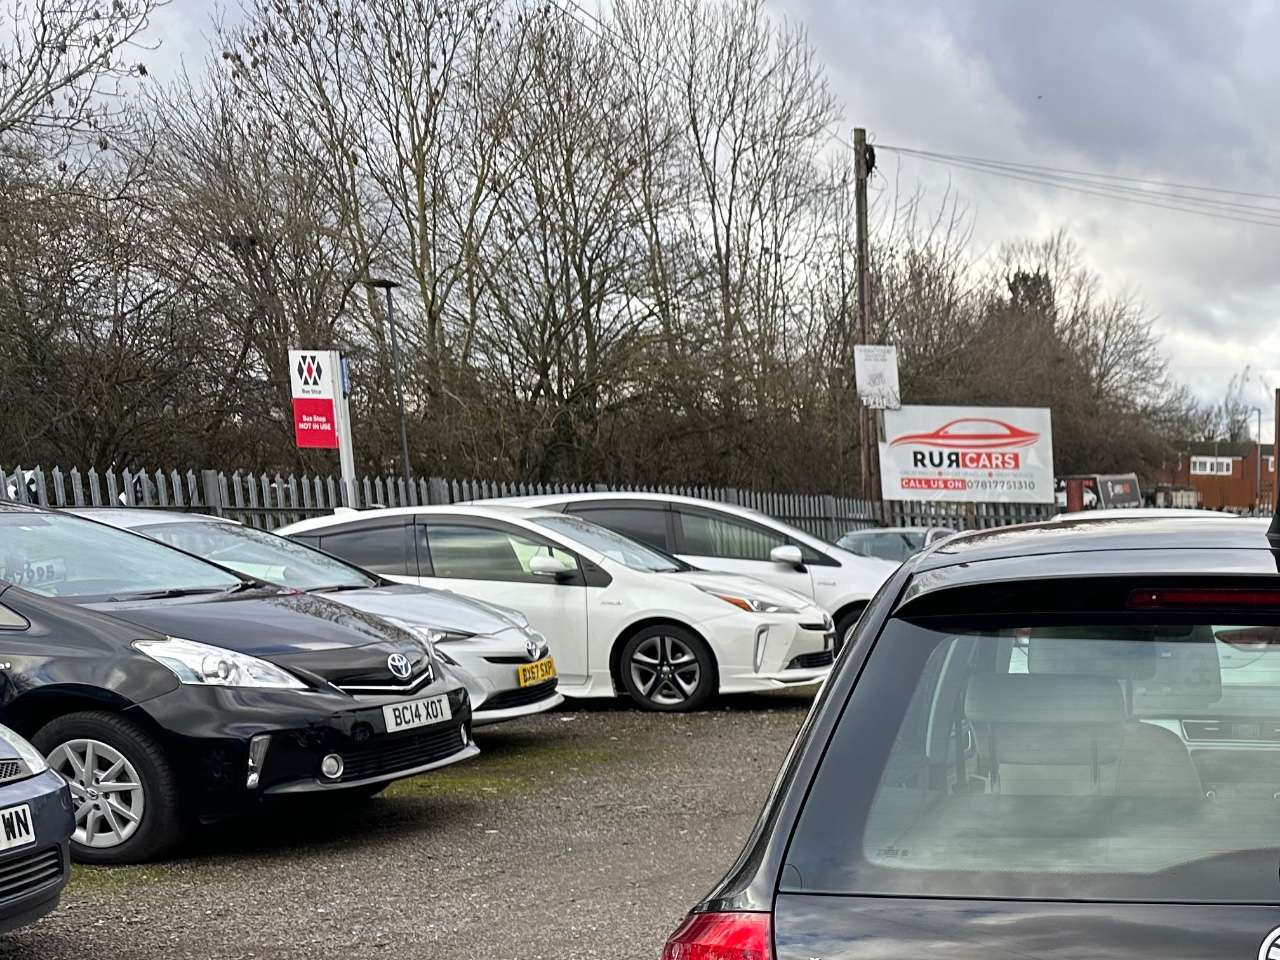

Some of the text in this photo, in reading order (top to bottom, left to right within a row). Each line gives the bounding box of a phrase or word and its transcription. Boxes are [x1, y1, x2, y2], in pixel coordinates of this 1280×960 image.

[902, 479, 929, 489] CALL
[930, 479, 945, 489] US
[392, 699, 444, 727] BC14 XOT
